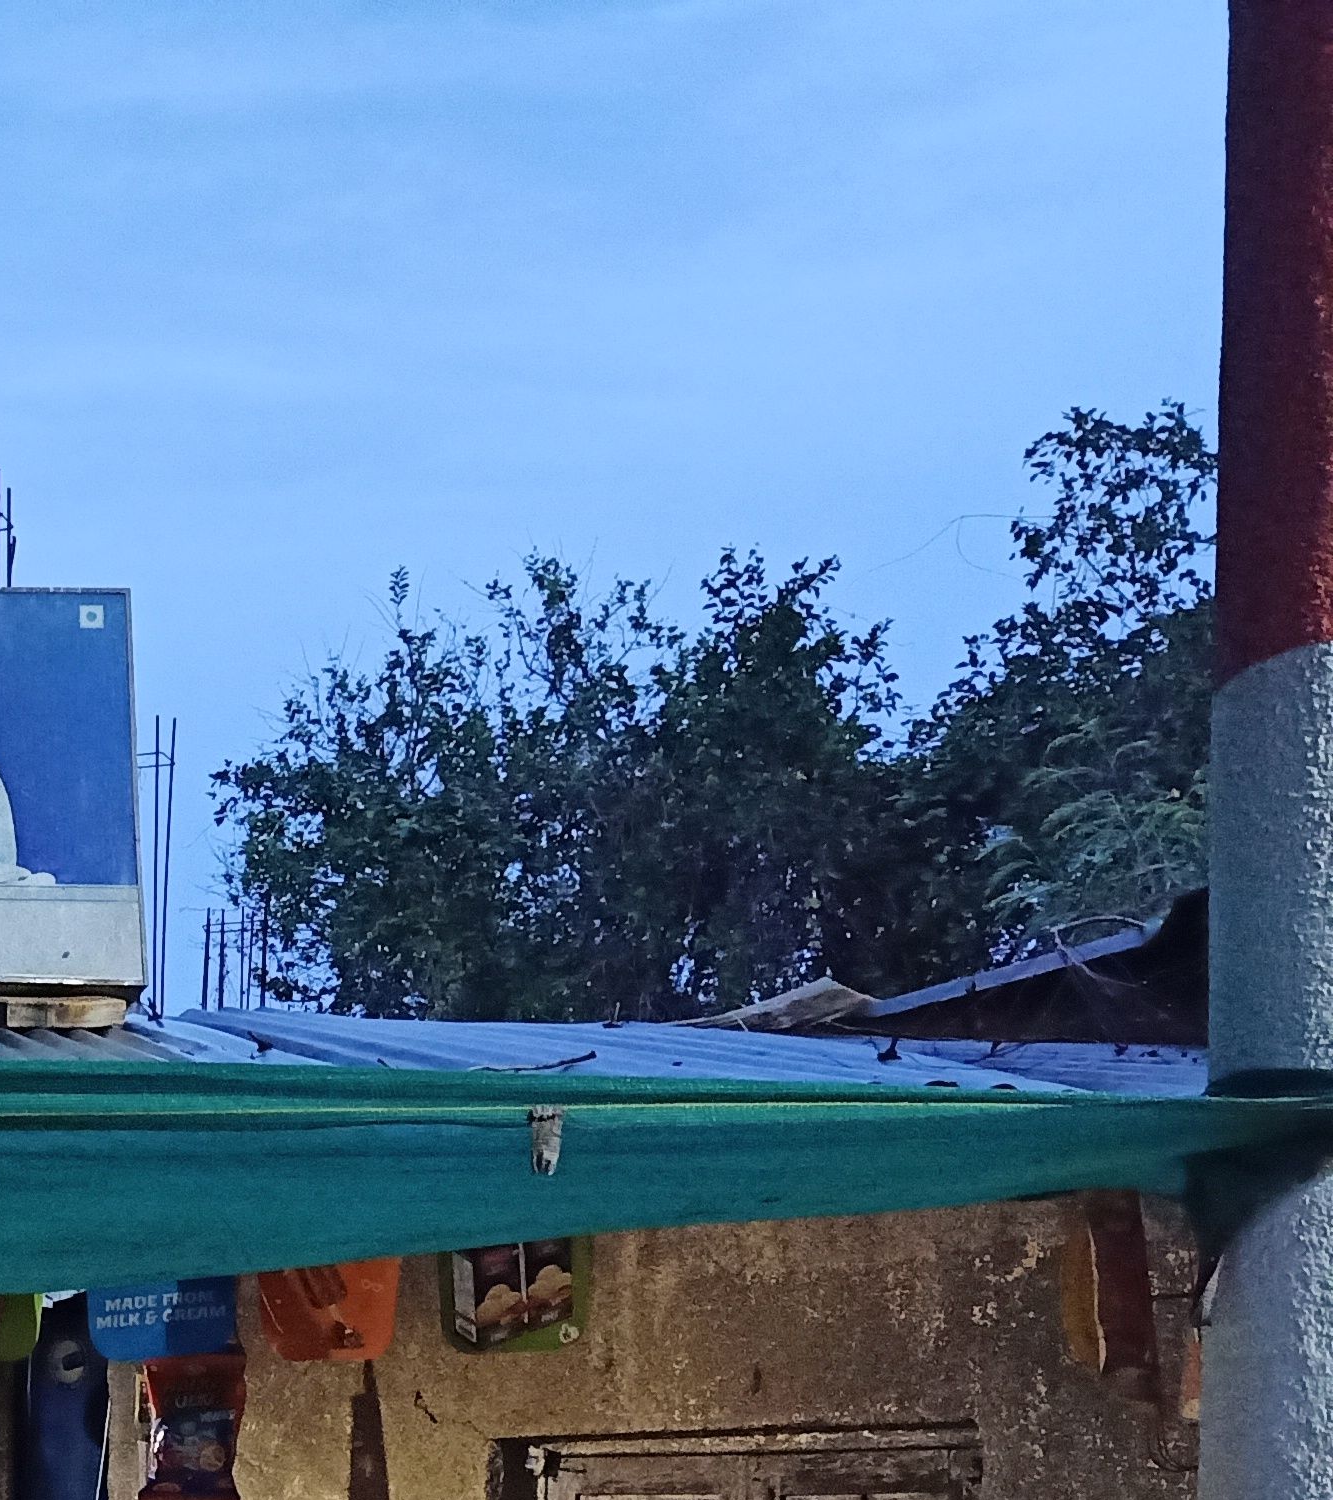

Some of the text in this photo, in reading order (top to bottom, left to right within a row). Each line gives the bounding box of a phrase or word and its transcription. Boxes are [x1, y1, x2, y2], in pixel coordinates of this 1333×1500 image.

[105, 1291, 214, 1313] MADE FROM
[96, 1305, 227, 1330] MILK & CREAM
